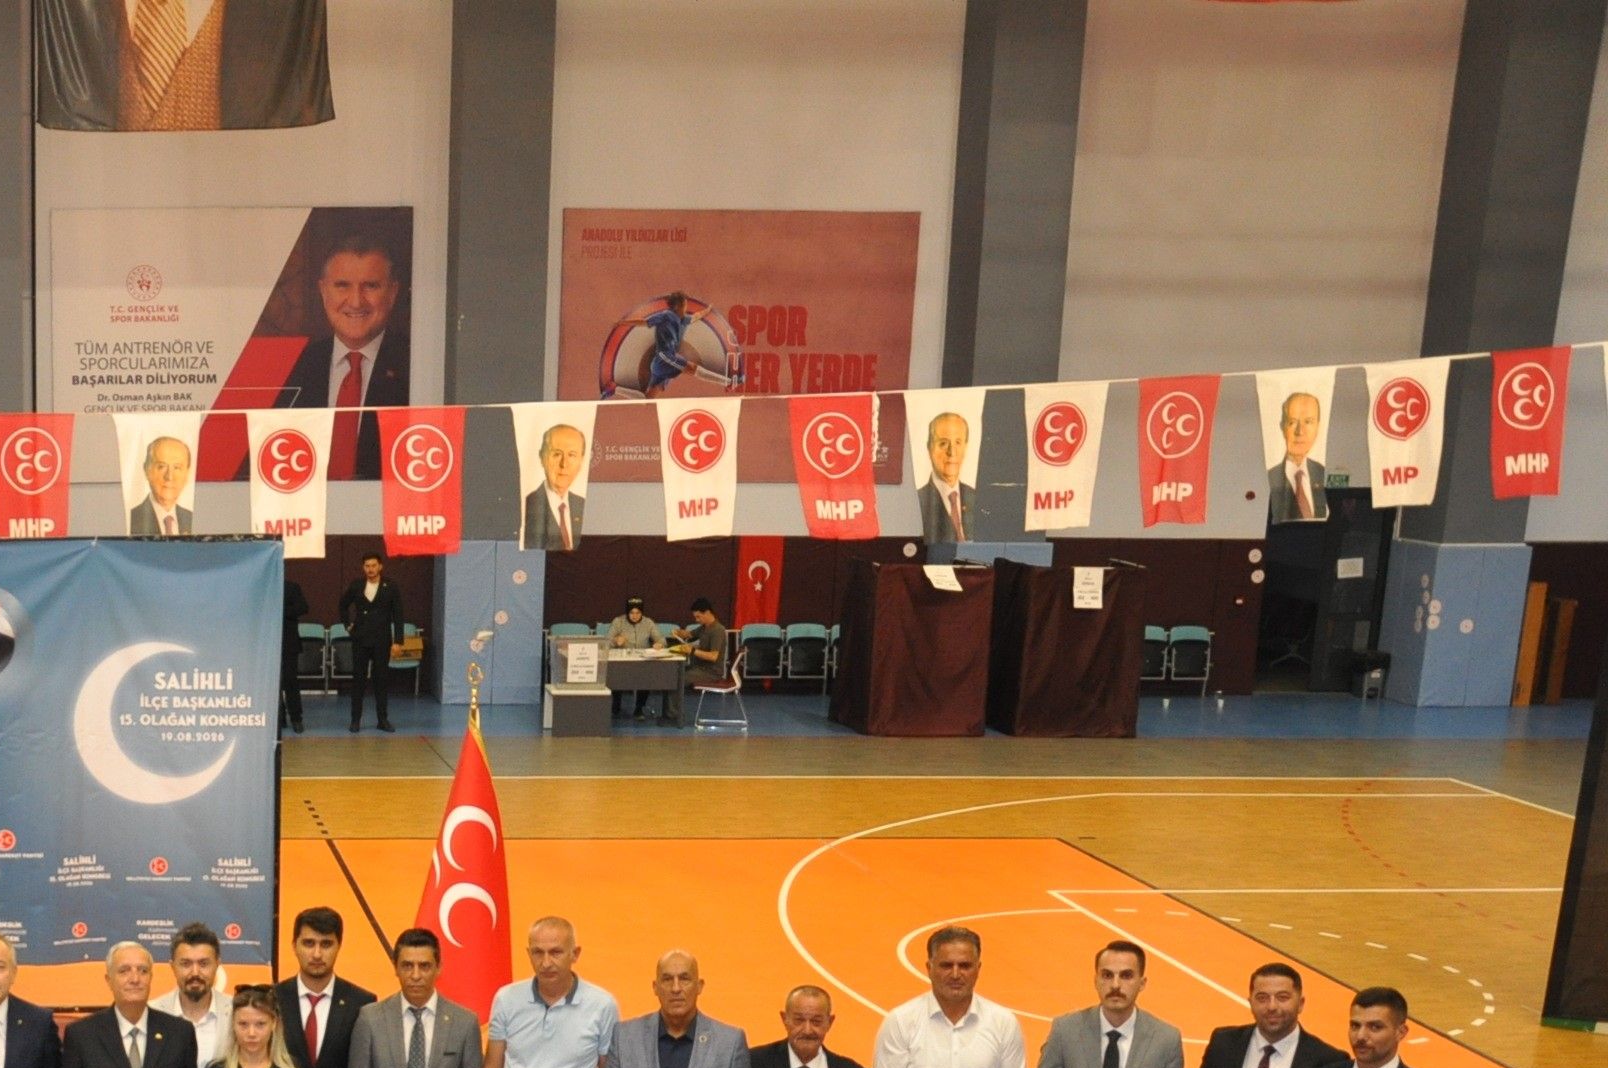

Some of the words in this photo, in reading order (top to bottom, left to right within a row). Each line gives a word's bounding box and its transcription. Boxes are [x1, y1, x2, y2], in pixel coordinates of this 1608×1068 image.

[727, 304, 809, 347] SPOR
[75, 340, 108, 355] TÜM
[113, 339, 193, 355] ANTRENÖR
[195, 341, 213, 354] VE
[80, 356, 209, 371] SPORCULARIMIZA
[789, 353, 878, 393] YERDE
[72, 375, 143, 388] BAŞARILAR
[146, 372, 217, 385] DİLİYORUM
[97, 394, 110, 402] Dr.
[112, 393, 143, 402] Osman
[146, 393, 171, 403] Aşkın
[173, 392, 192, 401] BAK
[1505, 452, 1549, 476] MHP
[815, 499, 864, 521] MHP
[9, 518, 55, 538] MHP
[265, 518, 311, 537] MHP
[397, 515, 446, 536] MHP
[154, 668, 233, 691] SALİHLİ
[139, 692, 168, 711] İLÇE
[172, 694, 252, 711] BAŞKANLIĞI
[119, 714, 136, 726] 15.
[140, 710, 196, 727] OLAĞAN
[199, 711, 267, 727] KONGRESİ
